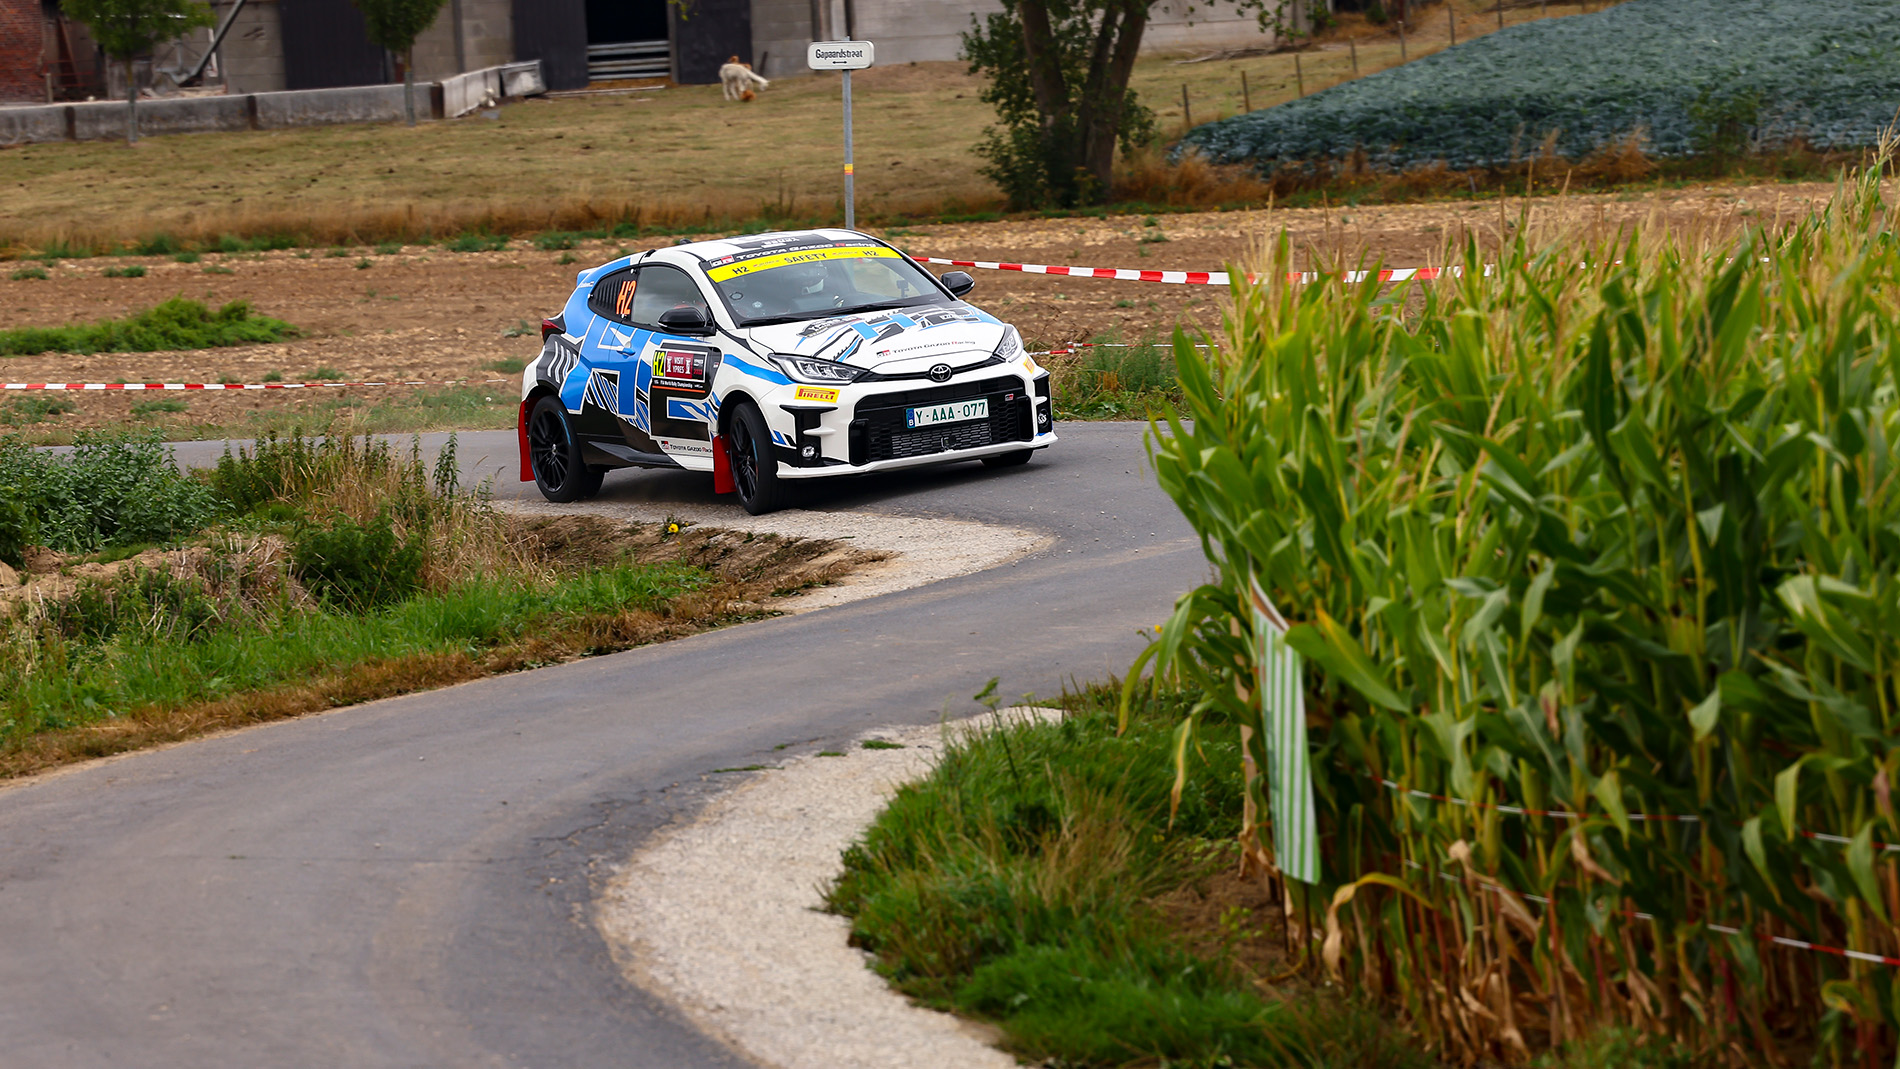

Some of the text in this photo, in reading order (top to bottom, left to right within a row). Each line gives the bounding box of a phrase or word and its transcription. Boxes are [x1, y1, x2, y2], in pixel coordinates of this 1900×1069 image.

[815, 48, 863, 60] Gapaardstraat
[736, 248, 787, 260] TOYOTA
[789, 243, 833, 252] GAZOO
[732, 266, 749, 275] H2
[784, 253, 827, 264] SAFETY
[616, 280, 636, 315] H2
[893, 345, 922, 353] TOYOTA
[653, 352, 664, 376] H2
[674, 356, 684, 364] VISIT
[673, 366, 684, 374] YPRES
[798, 388, 835, 400] PIRELLI
